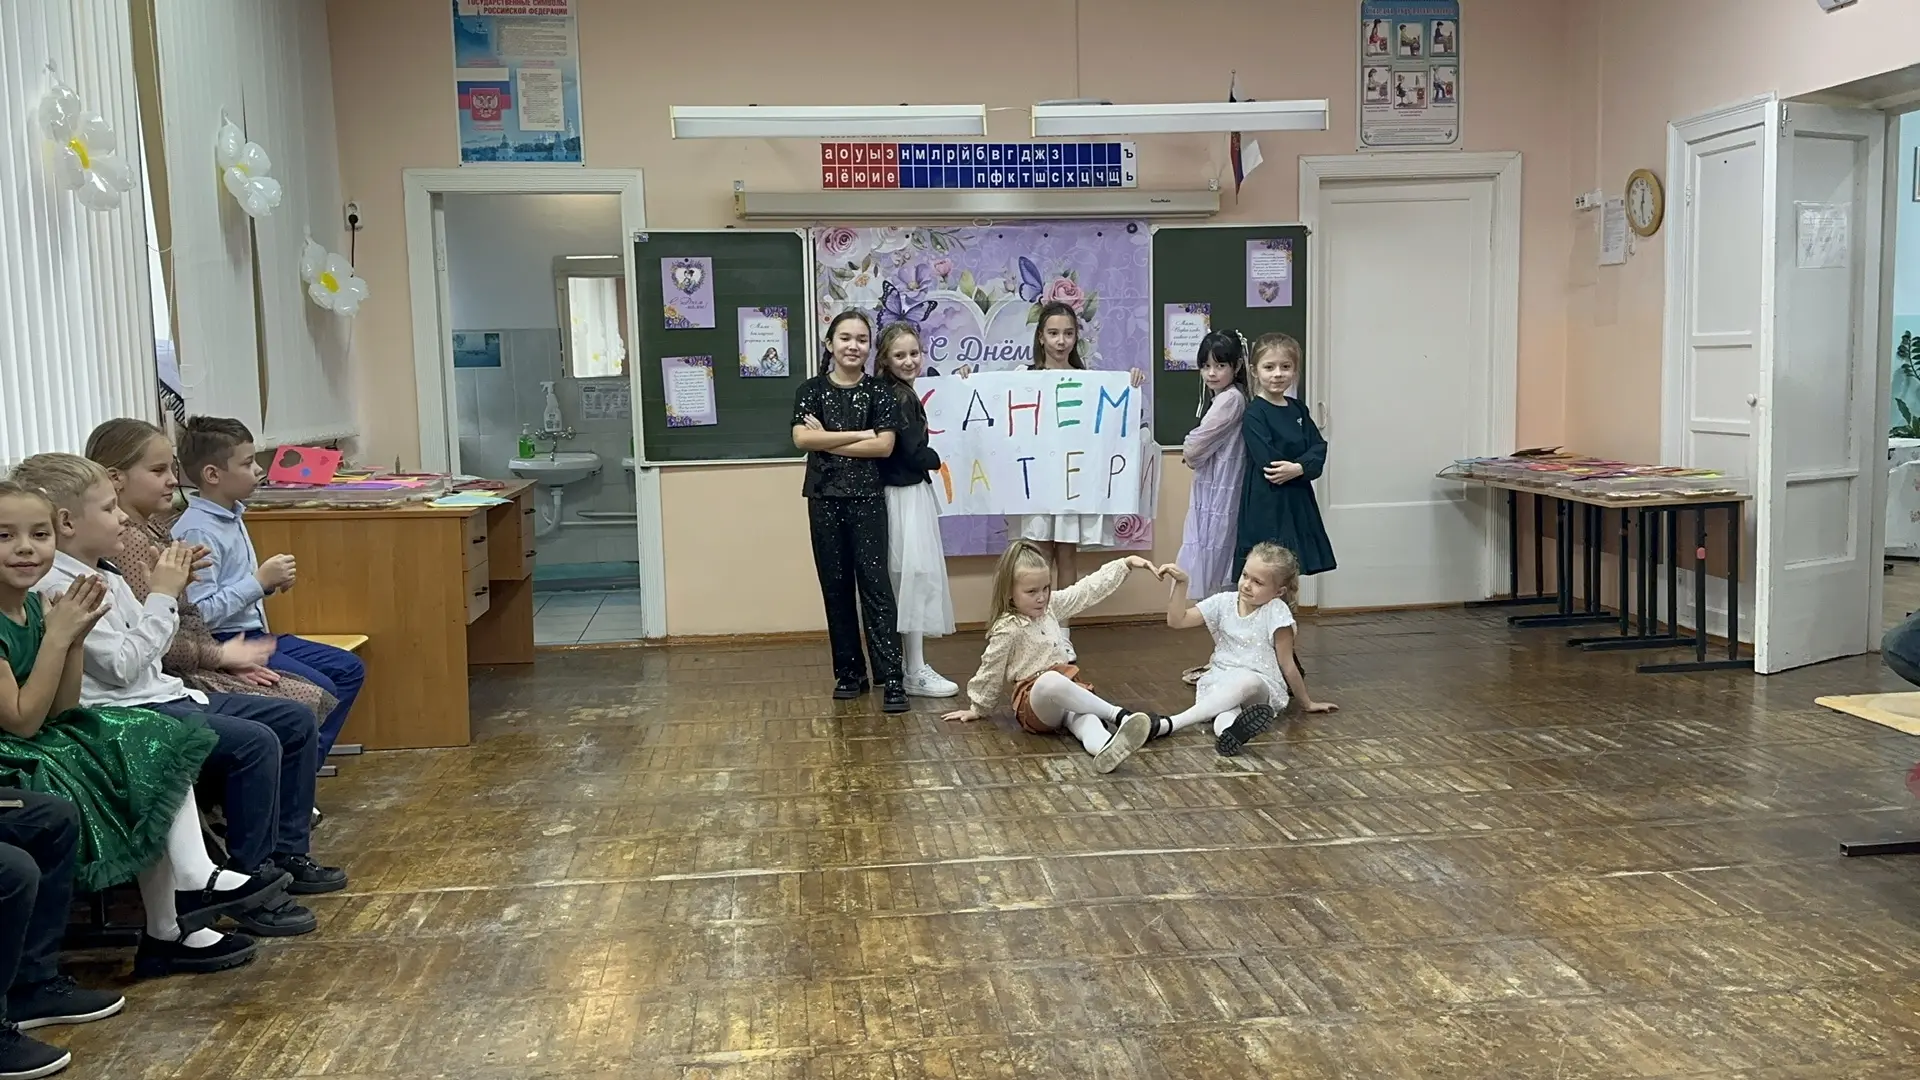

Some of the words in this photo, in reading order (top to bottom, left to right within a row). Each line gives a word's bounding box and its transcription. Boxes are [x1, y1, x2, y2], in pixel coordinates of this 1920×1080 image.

[483, 6, 527, 15] РОССИЙСКОЙ
[528, 7, 568, 16] ФЕДЕРАЦИИ
[929, 336, 948, 361] С
[957, 336, 1033, 361] Днём
